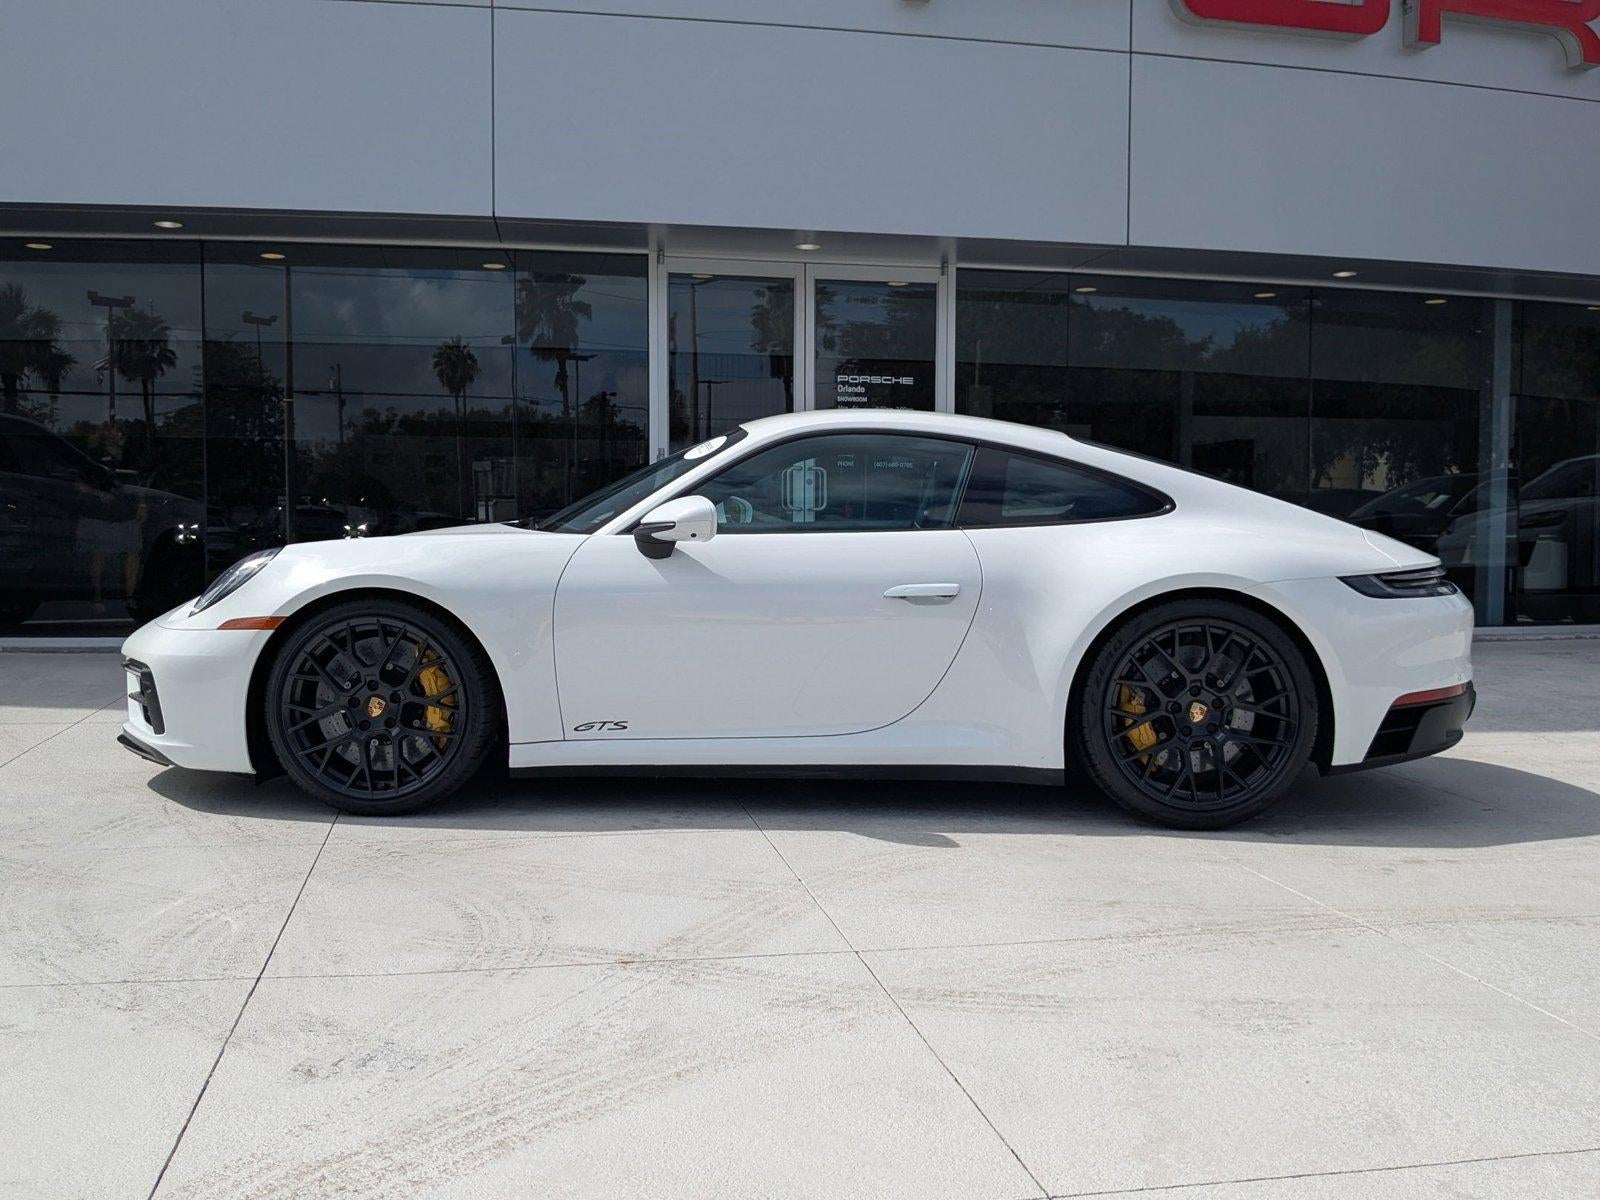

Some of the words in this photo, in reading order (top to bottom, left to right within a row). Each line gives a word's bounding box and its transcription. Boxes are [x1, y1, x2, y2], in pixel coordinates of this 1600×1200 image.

[837, 375, 914, 385] PORSCHE
[837, 385, 866, 393] Orlando
[573, 720, 629, 732] GTS
